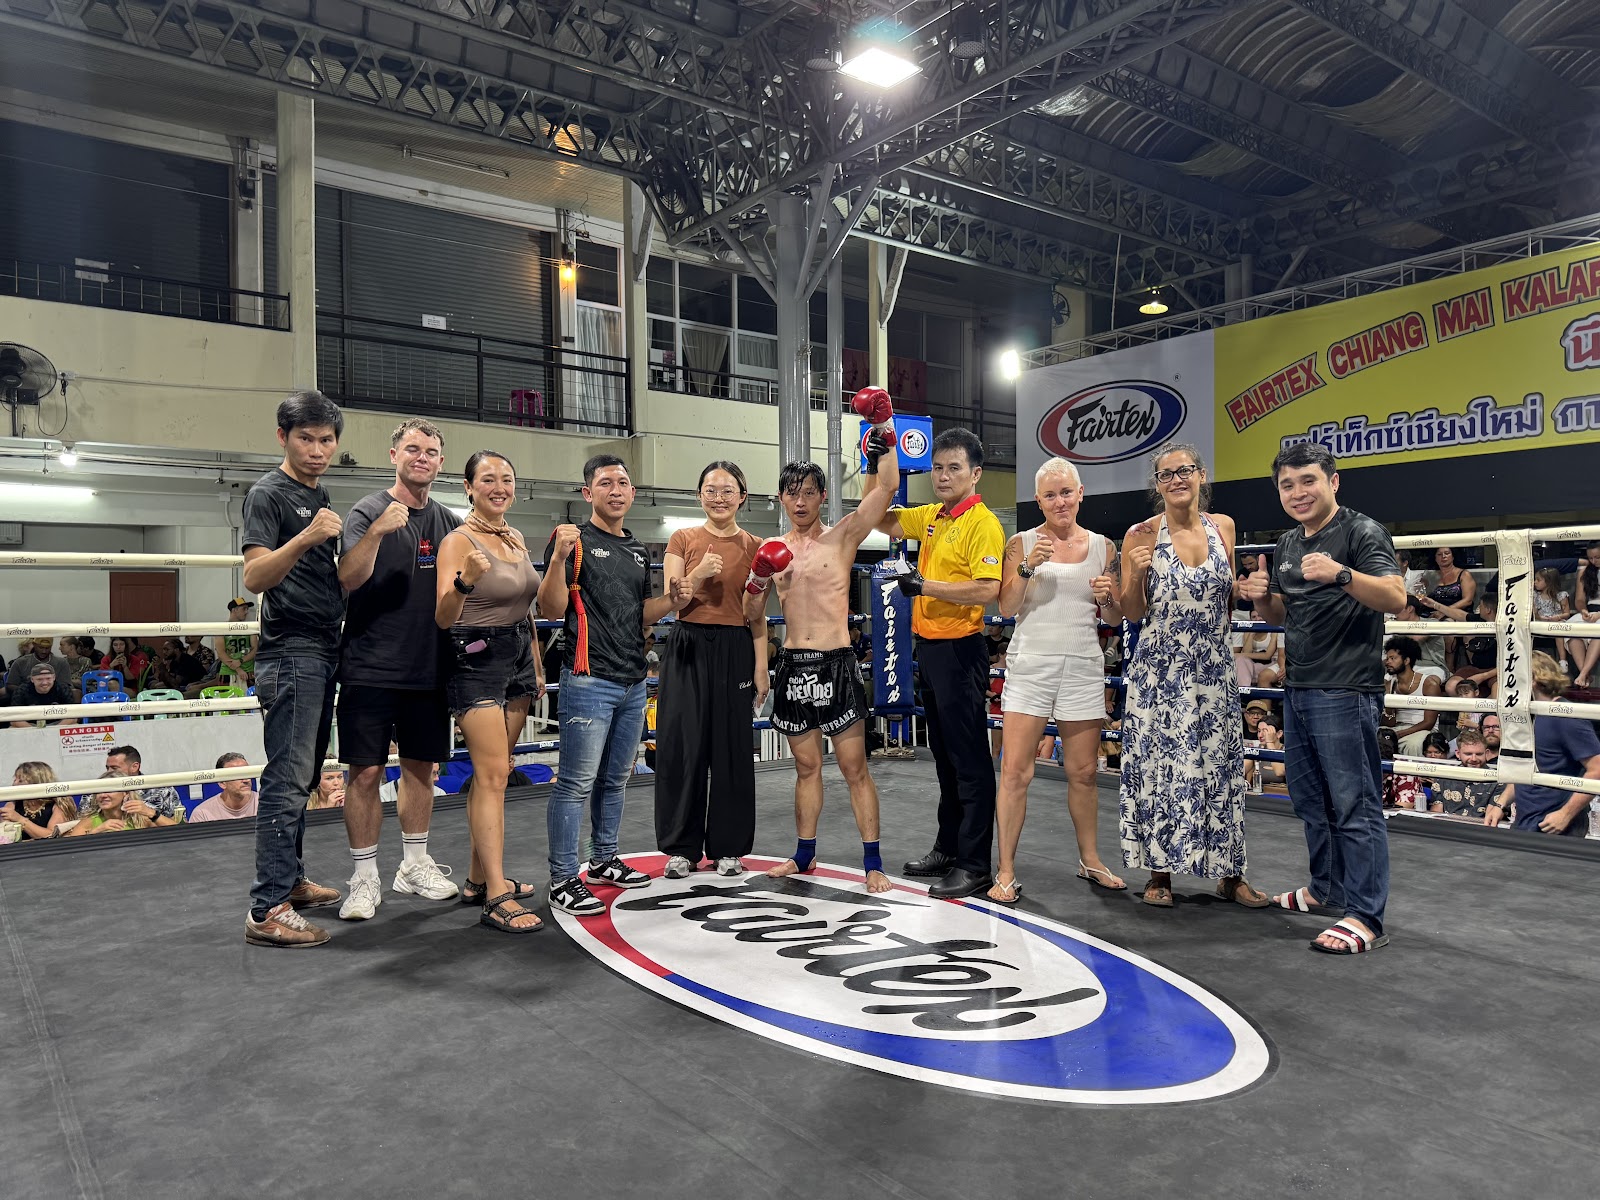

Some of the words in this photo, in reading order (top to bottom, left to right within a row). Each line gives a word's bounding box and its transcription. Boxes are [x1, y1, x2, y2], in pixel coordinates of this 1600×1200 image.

[1067, 395, 1155, 450] Fairtex
[1226, 353, 1325, 431] FAIRTEX
[1328, 313, 1427, 377] CHIANG
[1434, 288, 1494, 340] MAI
[880, 580, 901, 703] Fairtex
[1505, 572, 1529, 707] Fairtex
[64, 726, 110, 735] DANGER!
[615, 873, 1101, 1031] Fairtex
